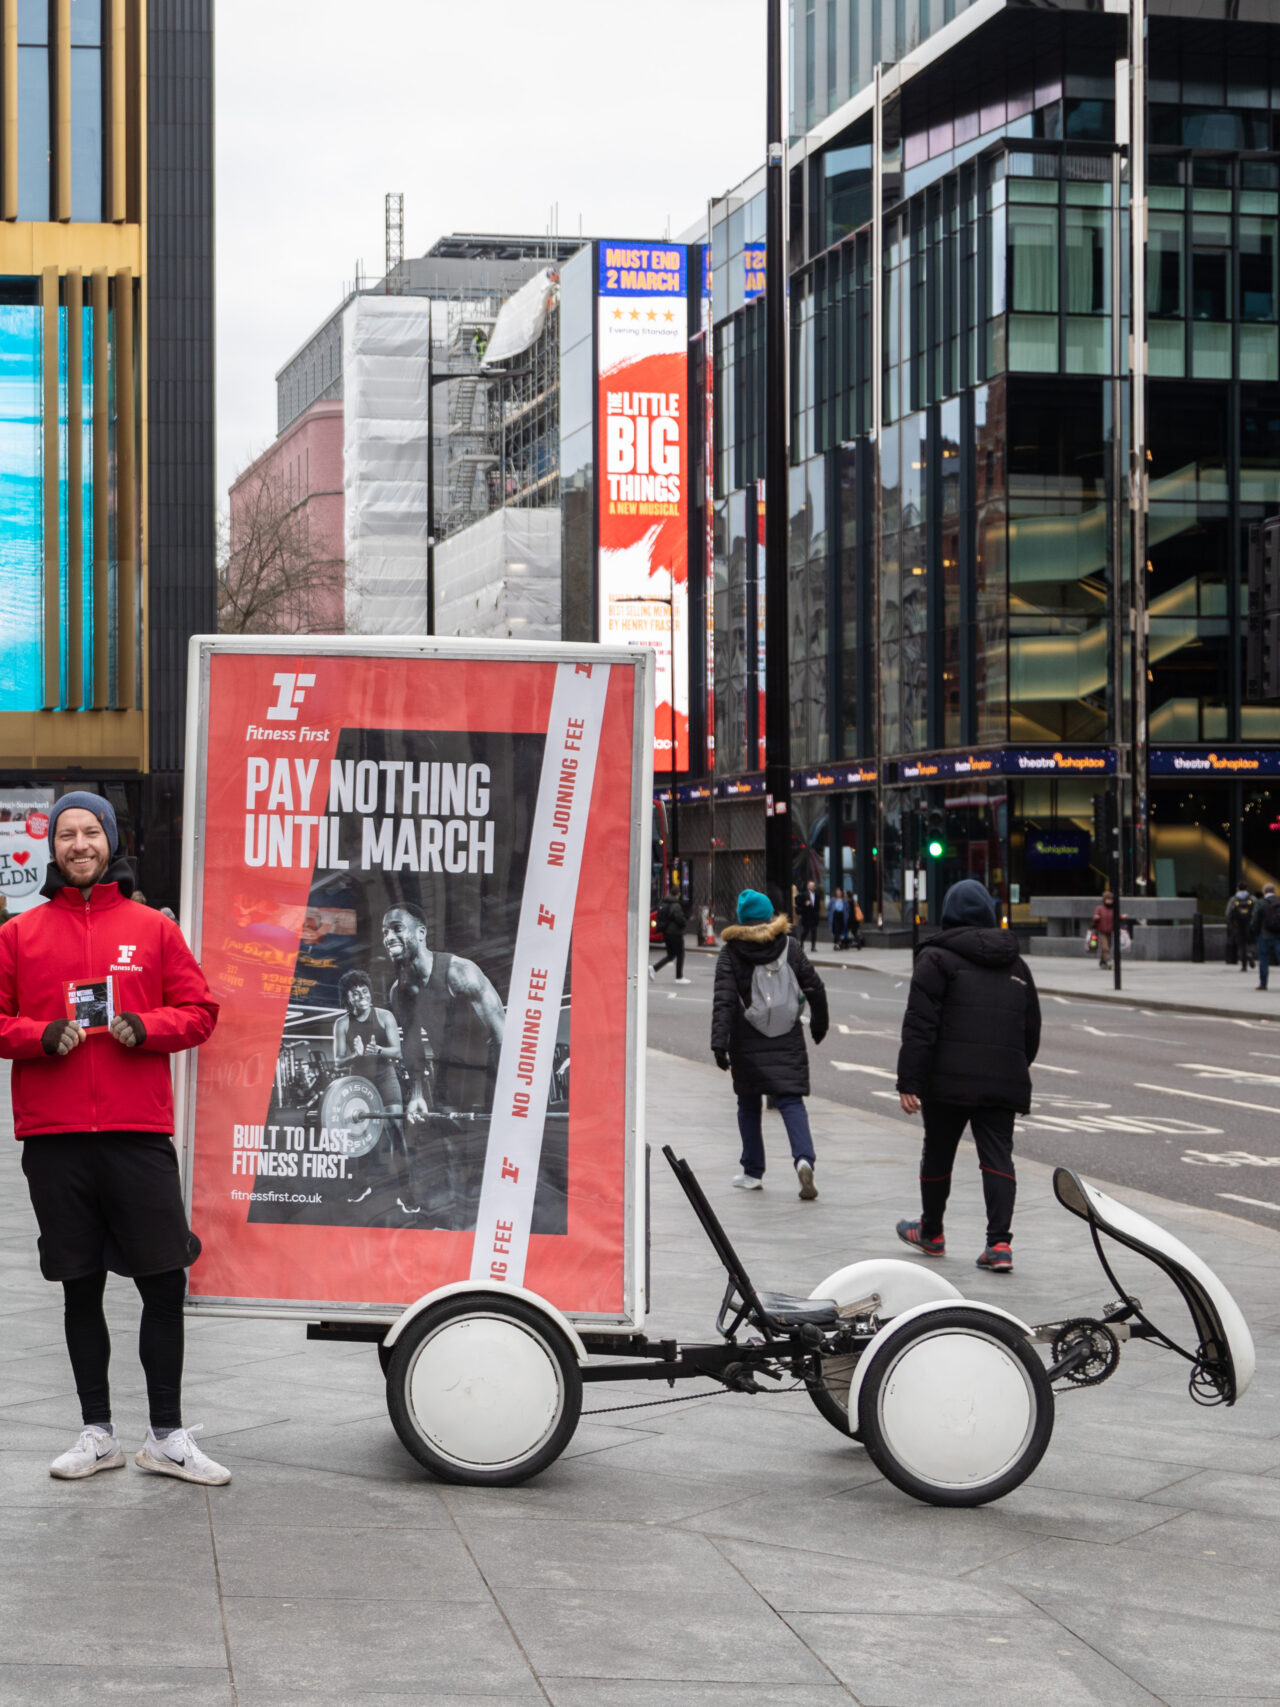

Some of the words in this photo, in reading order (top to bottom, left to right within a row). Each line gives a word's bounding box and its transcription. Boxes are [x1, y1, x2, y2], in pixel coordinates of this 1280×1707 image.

[606, 248, 649, 268] MUST
[651, 250, 680, 270] END
[606, 269, 618, 288] 2
[620, 271, 680, 291] MARCH
[607, 391, 622, 415] THE
[623, 391, 680, 417] LITTLE
[607, 415, 680, 475] BIG
[607, 474, 680, 503] THINGS
[609, 502, 616, 514] A
[617, 502, 637, 515] NEW
[639, 503, 680, 516] MUSICAL
[564, 717, 584, 751] FEE
[1019, 756, 1055, 768] theatre
[1174, 757, 1210, 769] theatre
[246, 757, 319, 811] PAY
[329, 759, 491, 817] NOTHING
[553, 758, 579, 835] JOINING
[244, 814, 349, 869] UNTIL
[361, 817, 495, 874] MARCH
[547, 841, 566, 867] NO
[0, 854, 11, 869] I
[528, 967, 548, 1002] FEE
[517, 1008, 542, 1086] JOINING
[511, 1093, 530, 1119] NO
[233, 1124, 280, 1149] BUILT
[284, 1126, 305, 1151] TO
[309, 1127, 355, 1153] LAST.
[232, 1150, 298, 1177] FITNESS
[302, 1153, 352, 1179] FIRST.
[231, 1190, 322, 1203] fitnessfirst.co.uk
[493, 1219, 513, 1255] FEE
